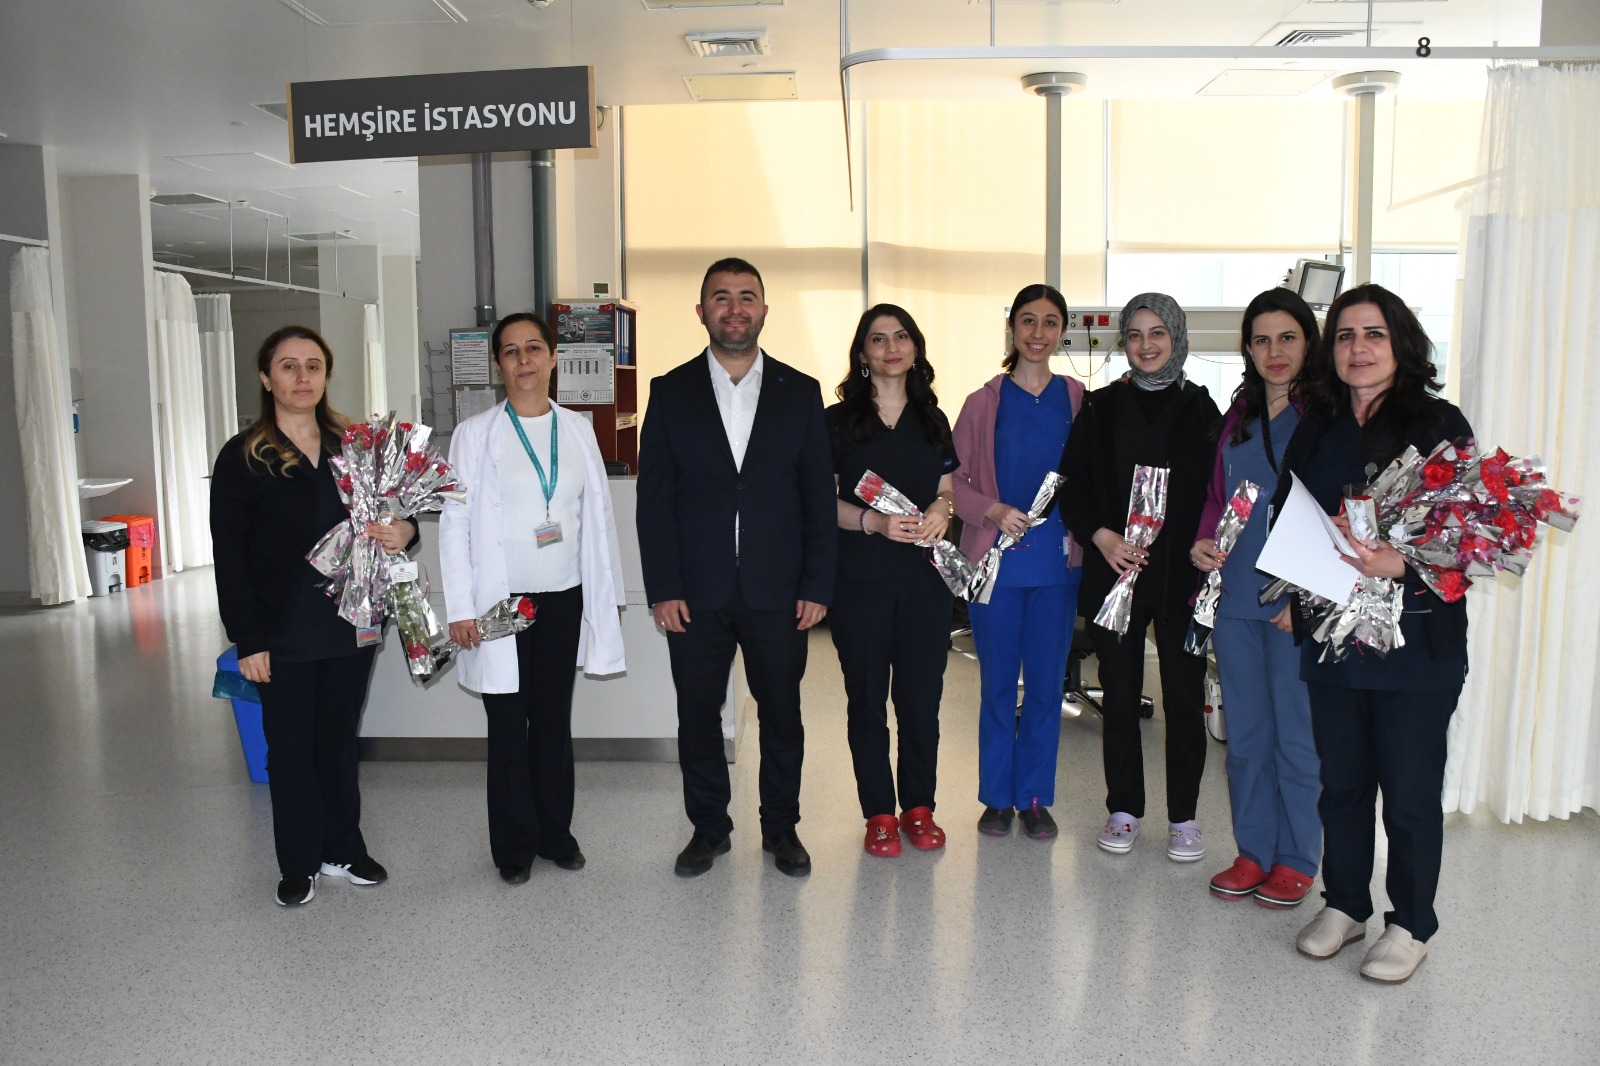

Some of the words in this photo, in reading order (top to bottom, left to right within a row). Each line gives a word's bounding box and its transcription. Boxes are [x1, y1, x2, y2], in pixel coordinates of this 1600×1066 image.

[1416, 37, 1431, 58] 8
[304, 105, 417, 142] HEMŞİRE
[424, 101, 576, 132] İSTASYONU
